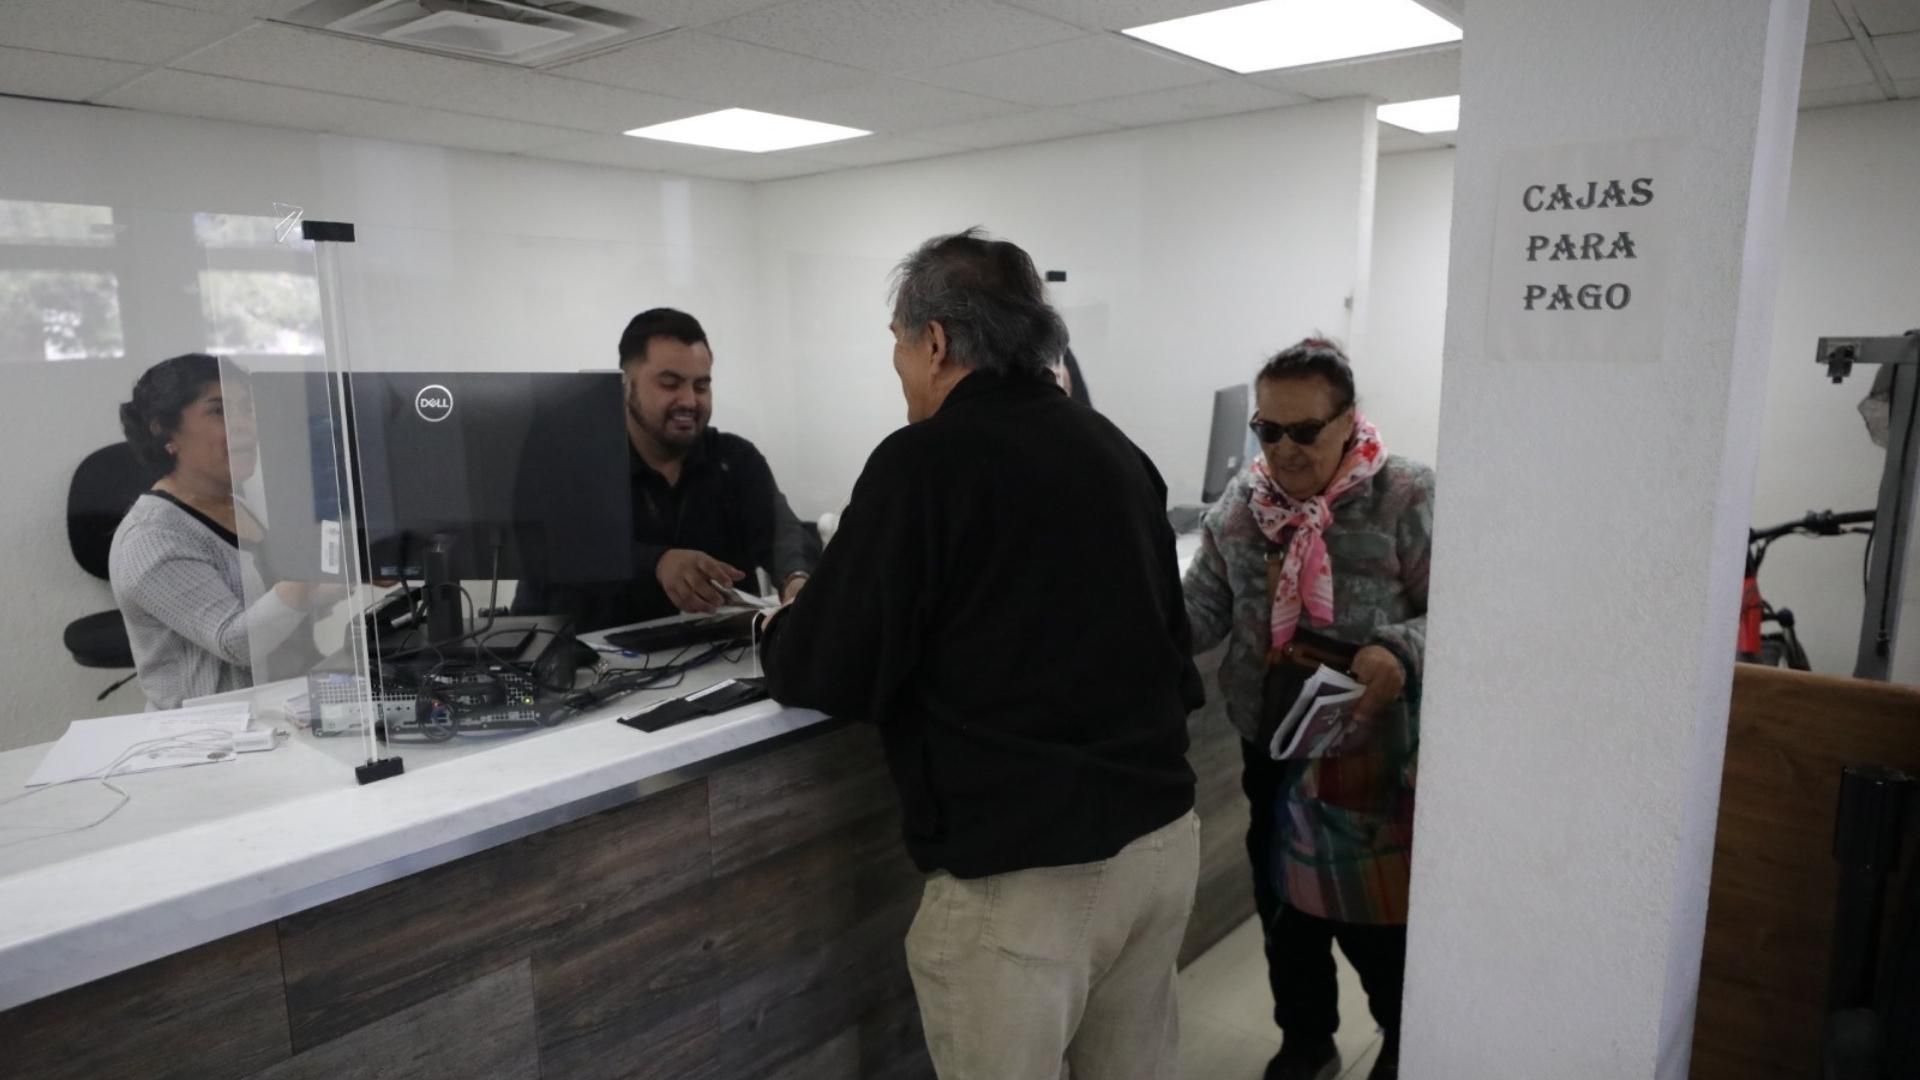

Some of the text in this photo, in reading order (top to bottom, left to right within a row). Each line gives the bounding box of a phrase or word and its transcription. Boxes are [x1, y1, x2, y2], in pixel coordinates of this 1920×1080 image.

[1523, 178, 1654, 212] CAJAS
[1526, 231, 1637, 261] PARA
[1523, 283, 1631, 310] PAGO
[420, 398, 449, 408] DELL
